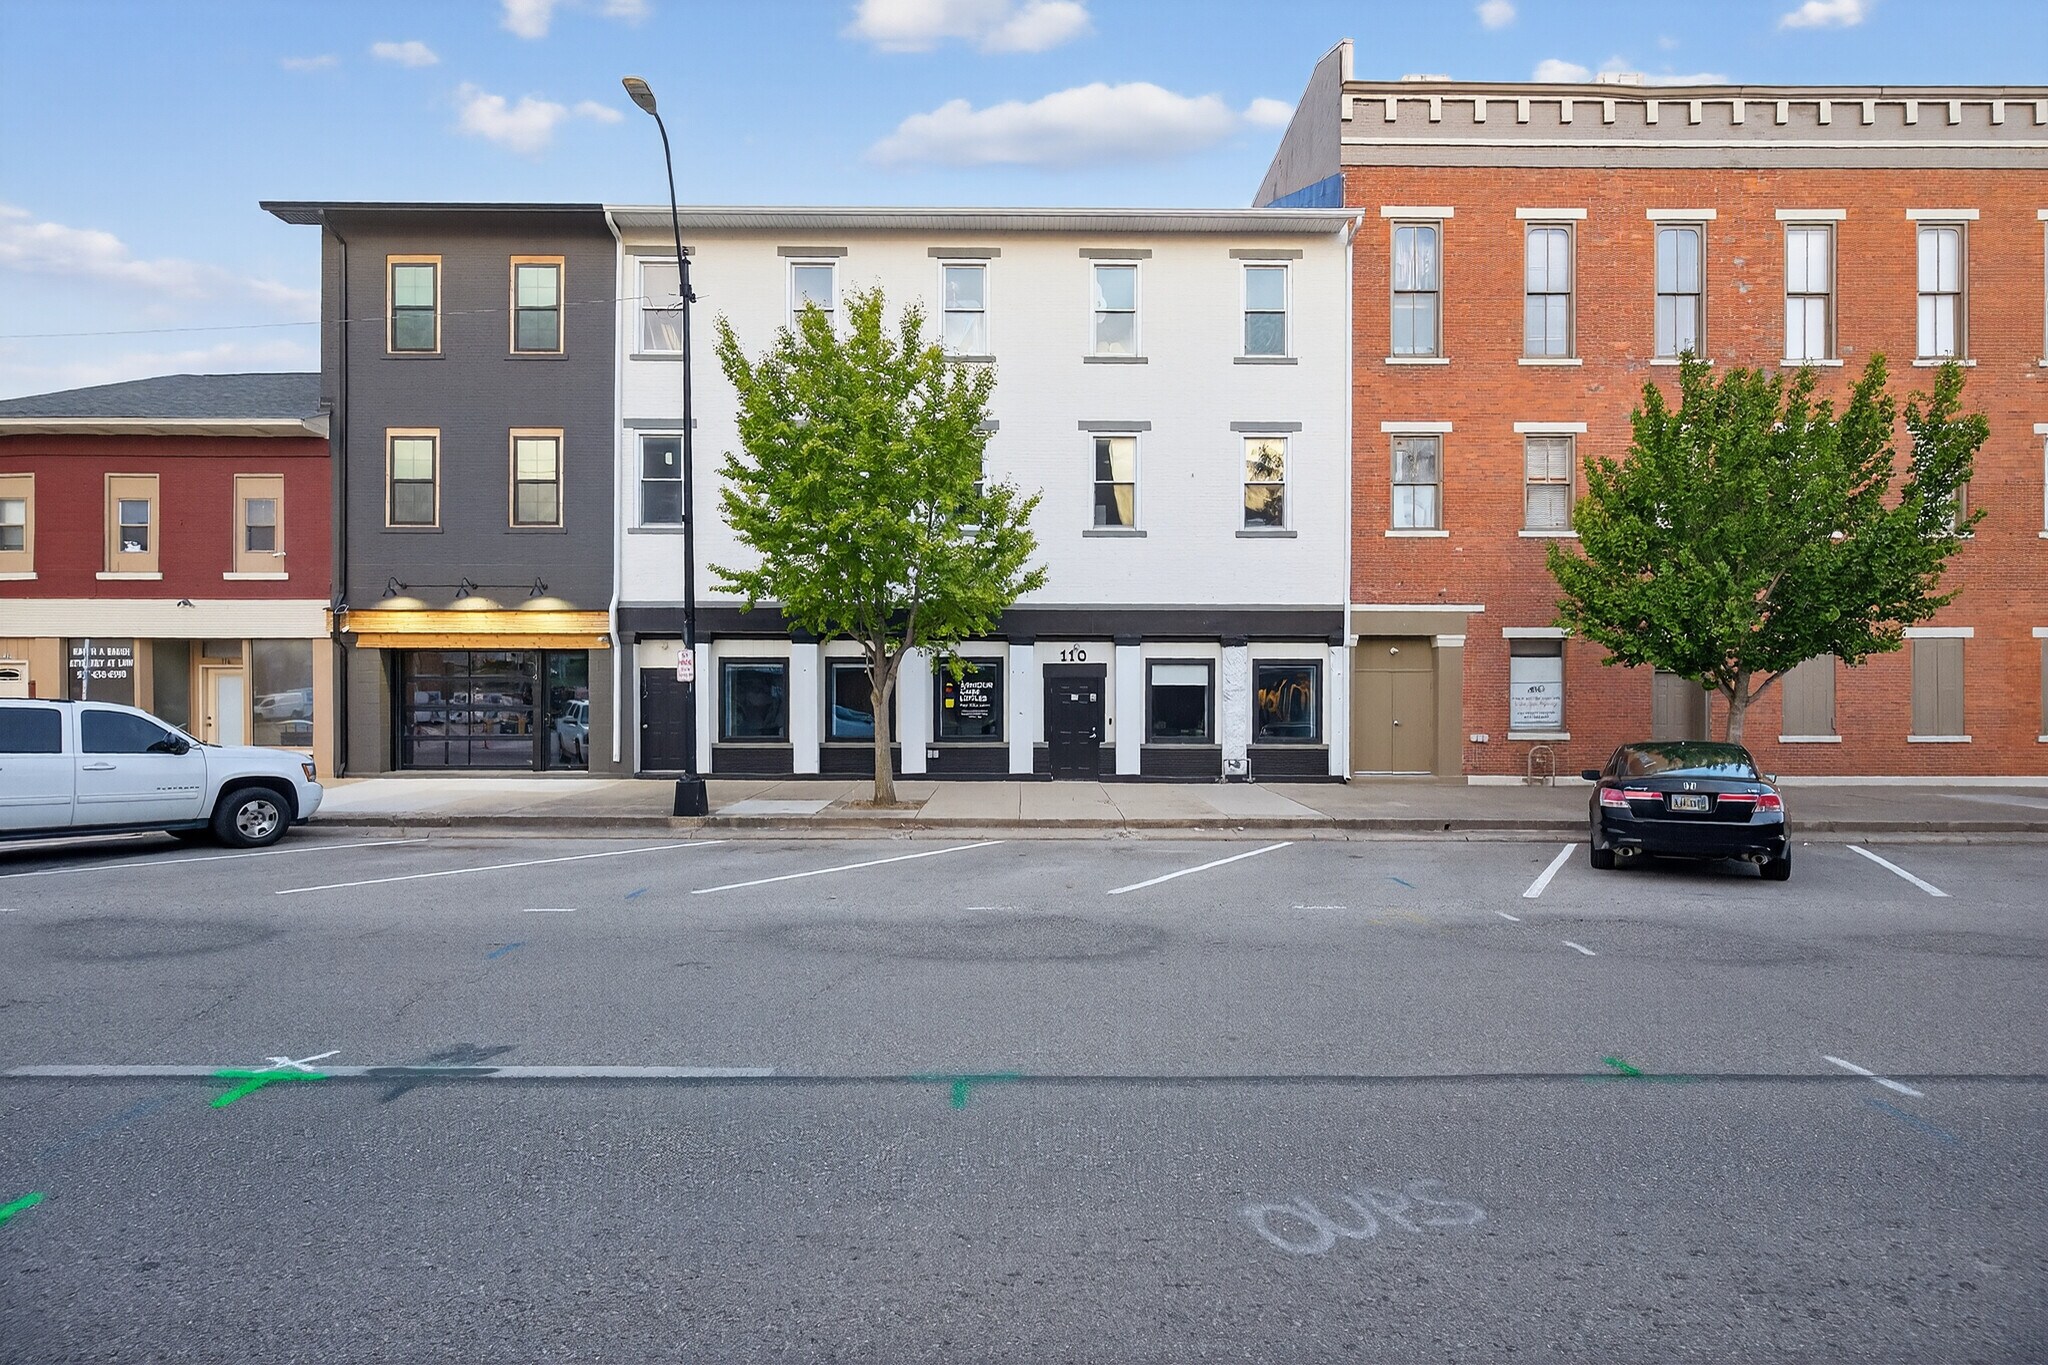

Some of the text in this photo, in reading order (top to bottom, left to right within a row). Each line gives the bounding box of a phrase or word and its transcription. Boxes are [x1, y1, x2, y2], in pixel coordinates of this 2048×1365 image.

[1060, 649, 1087, 662] 110
[107, 659, 116, 668] AT
[1239, 1178, 1486, 1255] OURS
